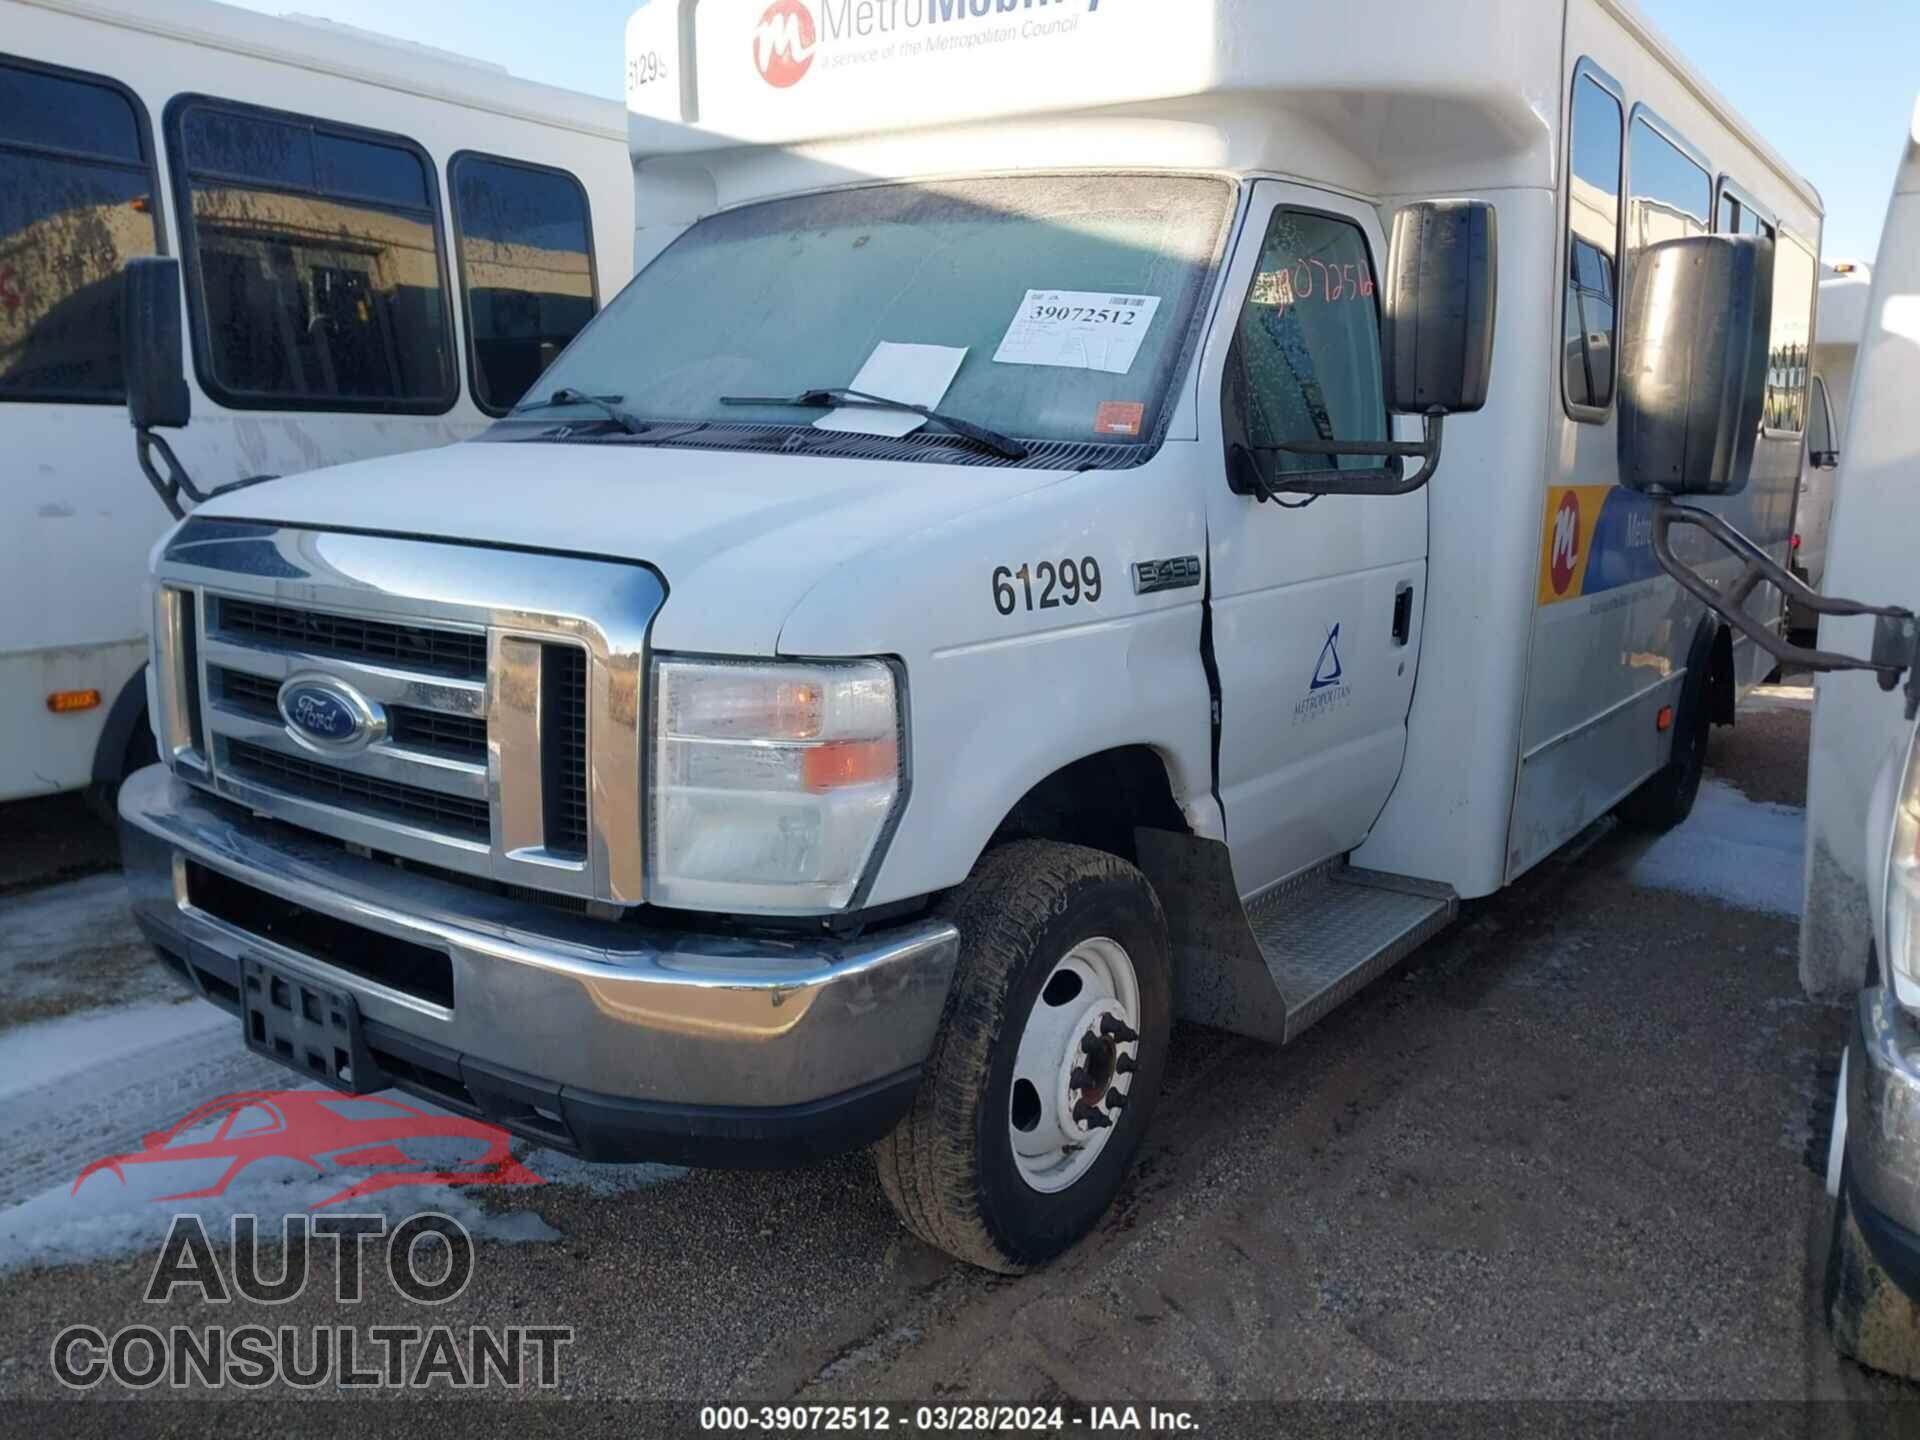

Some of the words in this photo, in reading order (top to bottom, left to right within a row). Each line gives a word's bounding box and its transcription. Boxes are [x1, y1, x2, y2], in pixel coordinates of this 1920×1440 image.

[831, 48, 879, 68] service
[899, 39, 922, 57] the
[926, 25, 1017, 53] Metropolitan
[1021, 14, 1081, 39] Council
[1029, 305, 1136, 326] 39072512
[992, 556, 1102, 616] 61299
[295, 695, 338, 733] Ford
